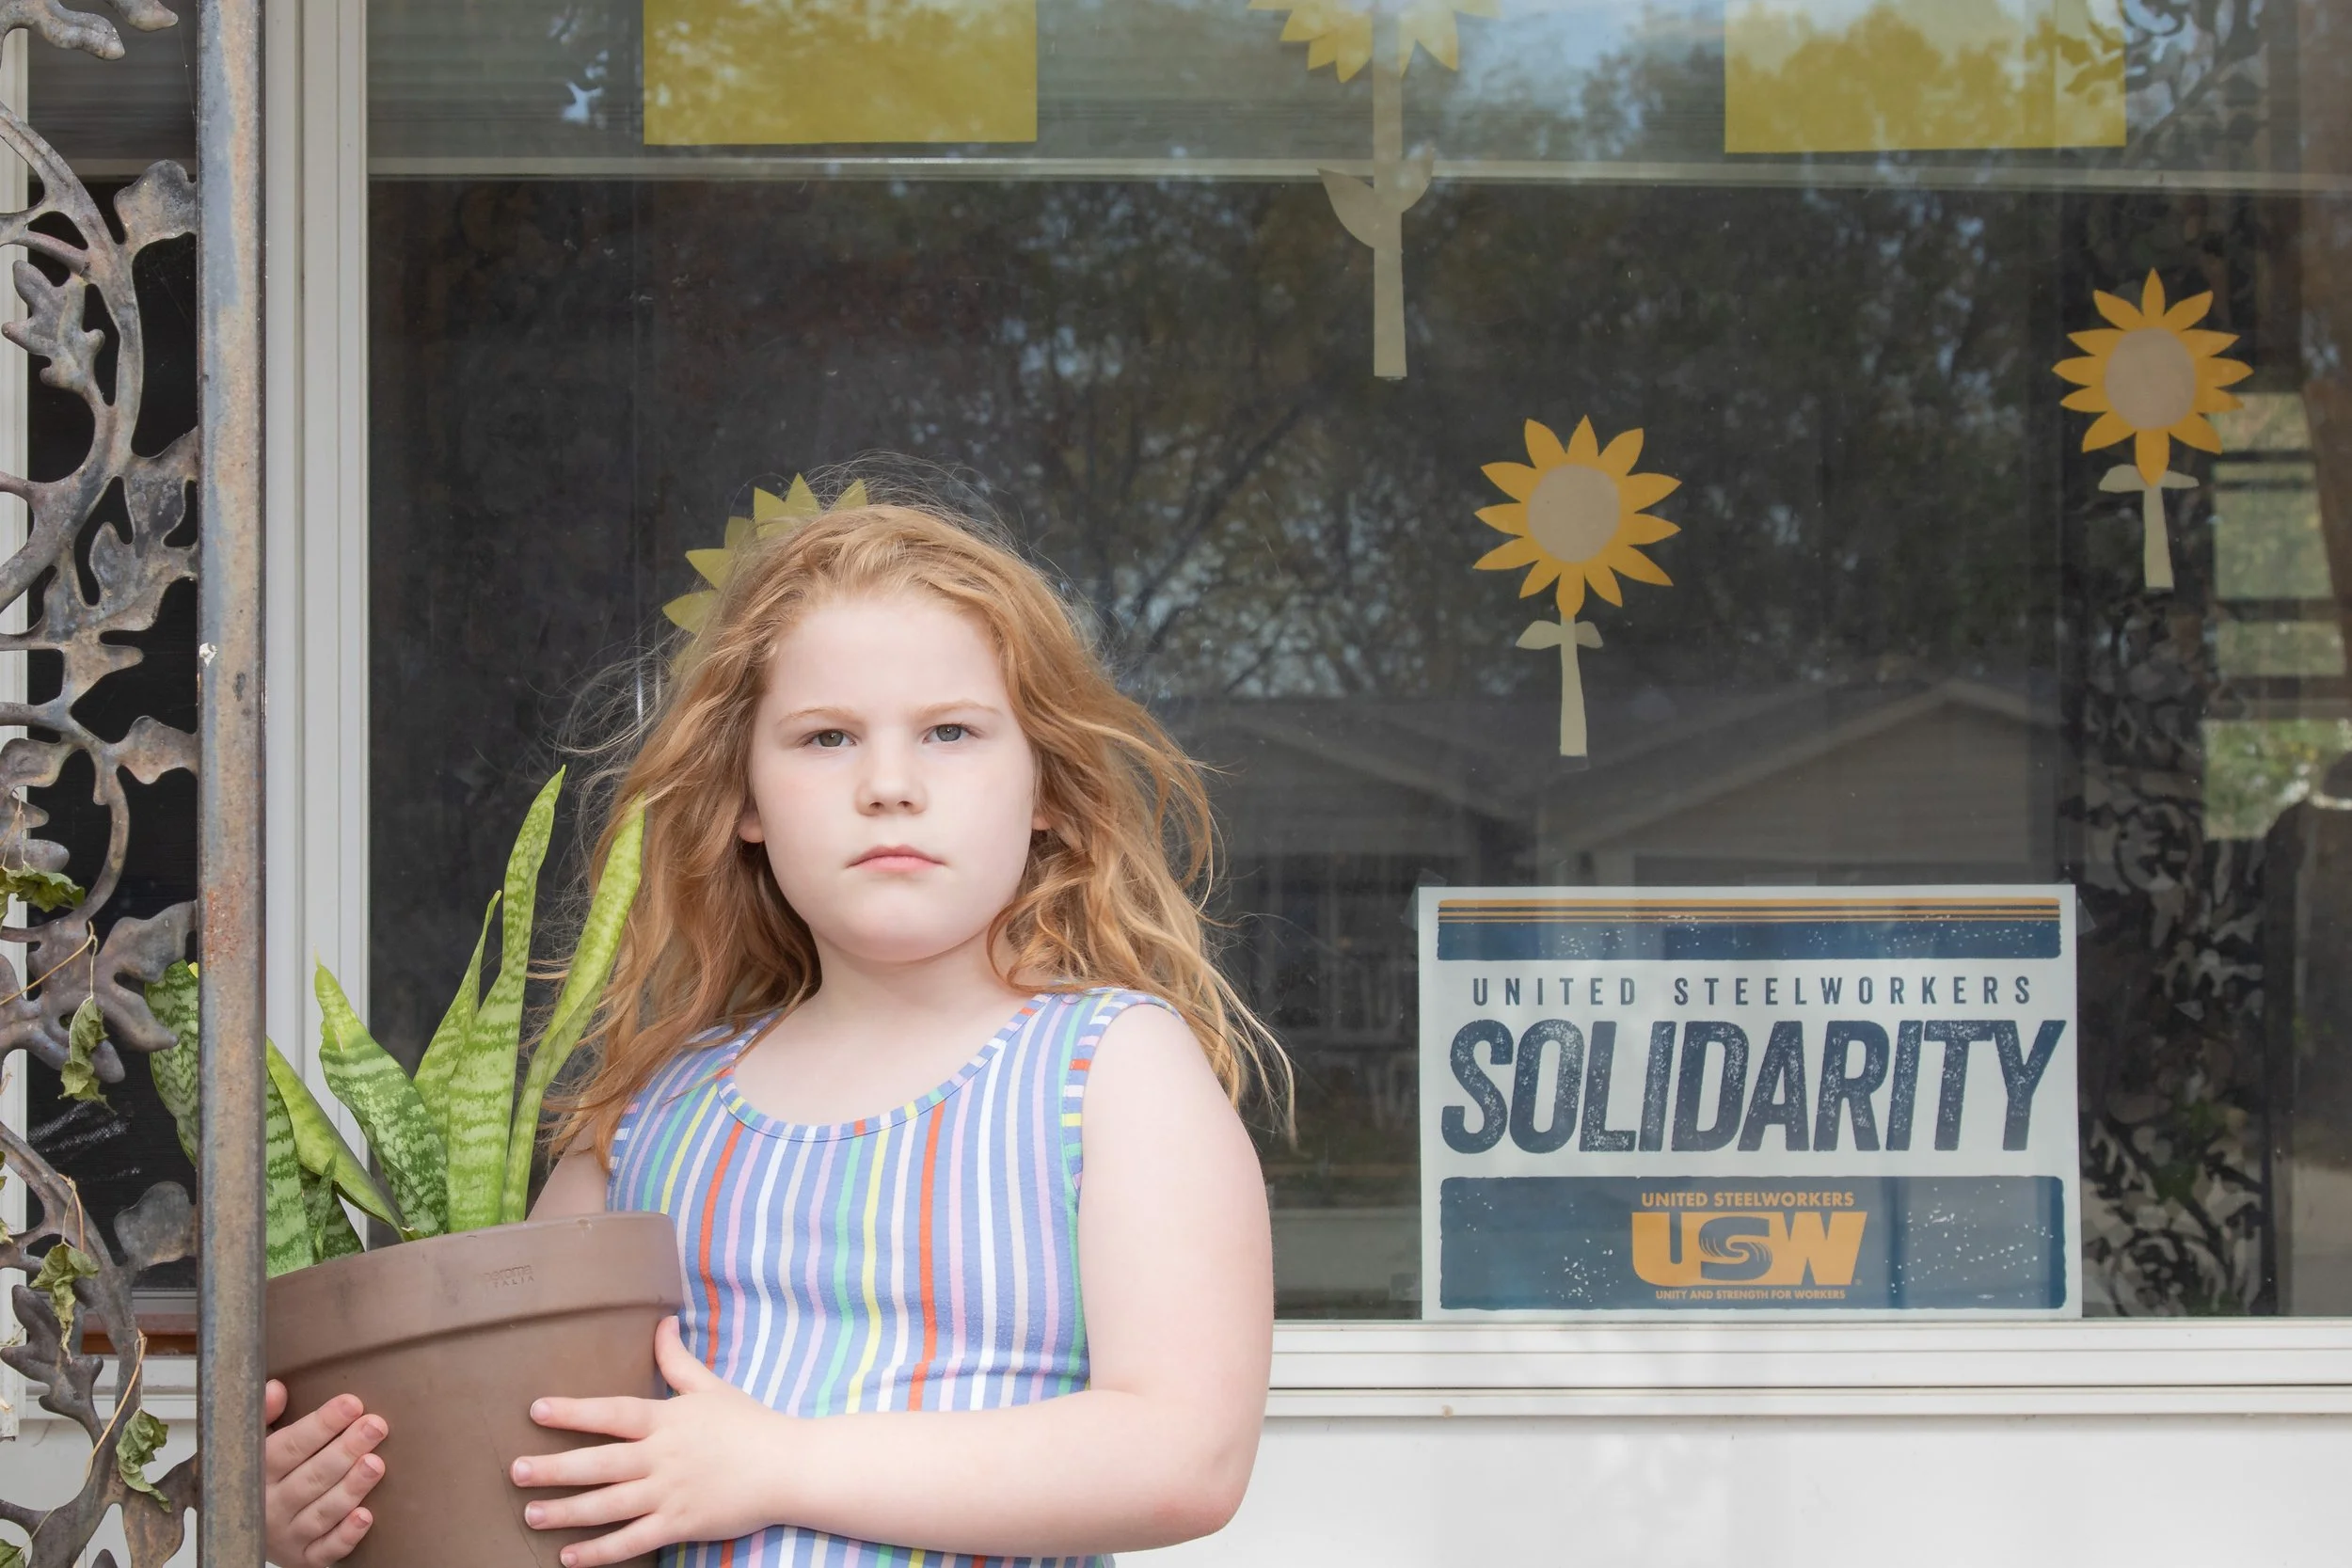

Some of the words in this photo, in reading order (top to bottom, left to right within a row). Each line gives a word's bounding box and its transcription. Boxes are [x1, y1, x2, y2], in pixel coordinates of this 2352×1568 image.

[1473, 977, 1636, 1006] UNITED
[1675, 975, 2030, 1005] STEELWORKERS
[1441, 1019, 2066, 1154] SOLIDARITY
[1642, 1192, 1708, 1207] UNITED
[1714, 1192, 1854, 1207] STEELWORKERS
[1631, 1212, 1867, 1287] USW
[1656, 1290, 1687, 1300] UNITY
[1690, 1290, 1712, 1300] AND
[1716, 1290, 1768, 1300] STRENGTH
[1771, 1290, 1791, 1300] FOR
[1794, 1290, 1846, 1300] WORKERS
